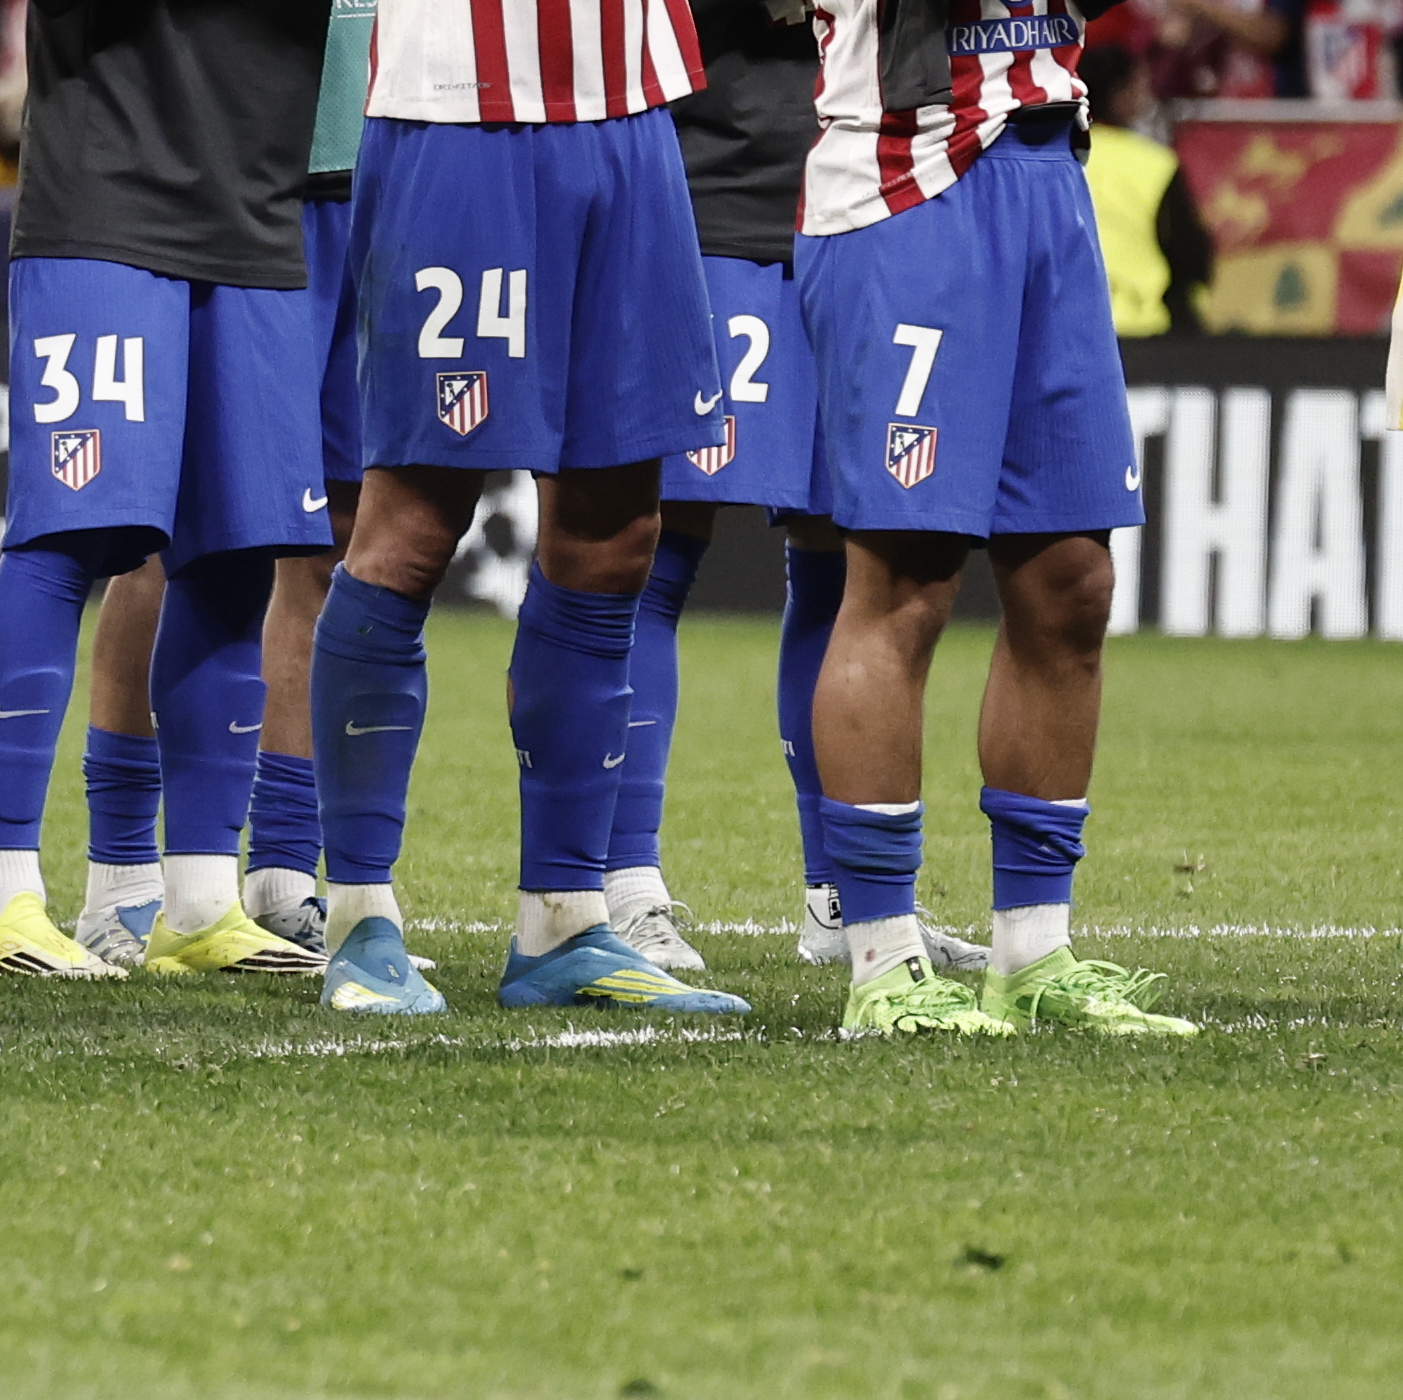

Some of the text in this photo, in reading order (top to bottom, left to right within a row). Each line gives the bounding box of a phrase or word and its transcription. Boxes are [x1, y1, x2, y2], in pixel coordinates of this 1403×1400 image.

[953, 18, 1075, 52] RIYADH AIR
[415, 266, 527, 359] 24
[33, 333, 145, 424] 34
[892, 323, 943, 417] 7
